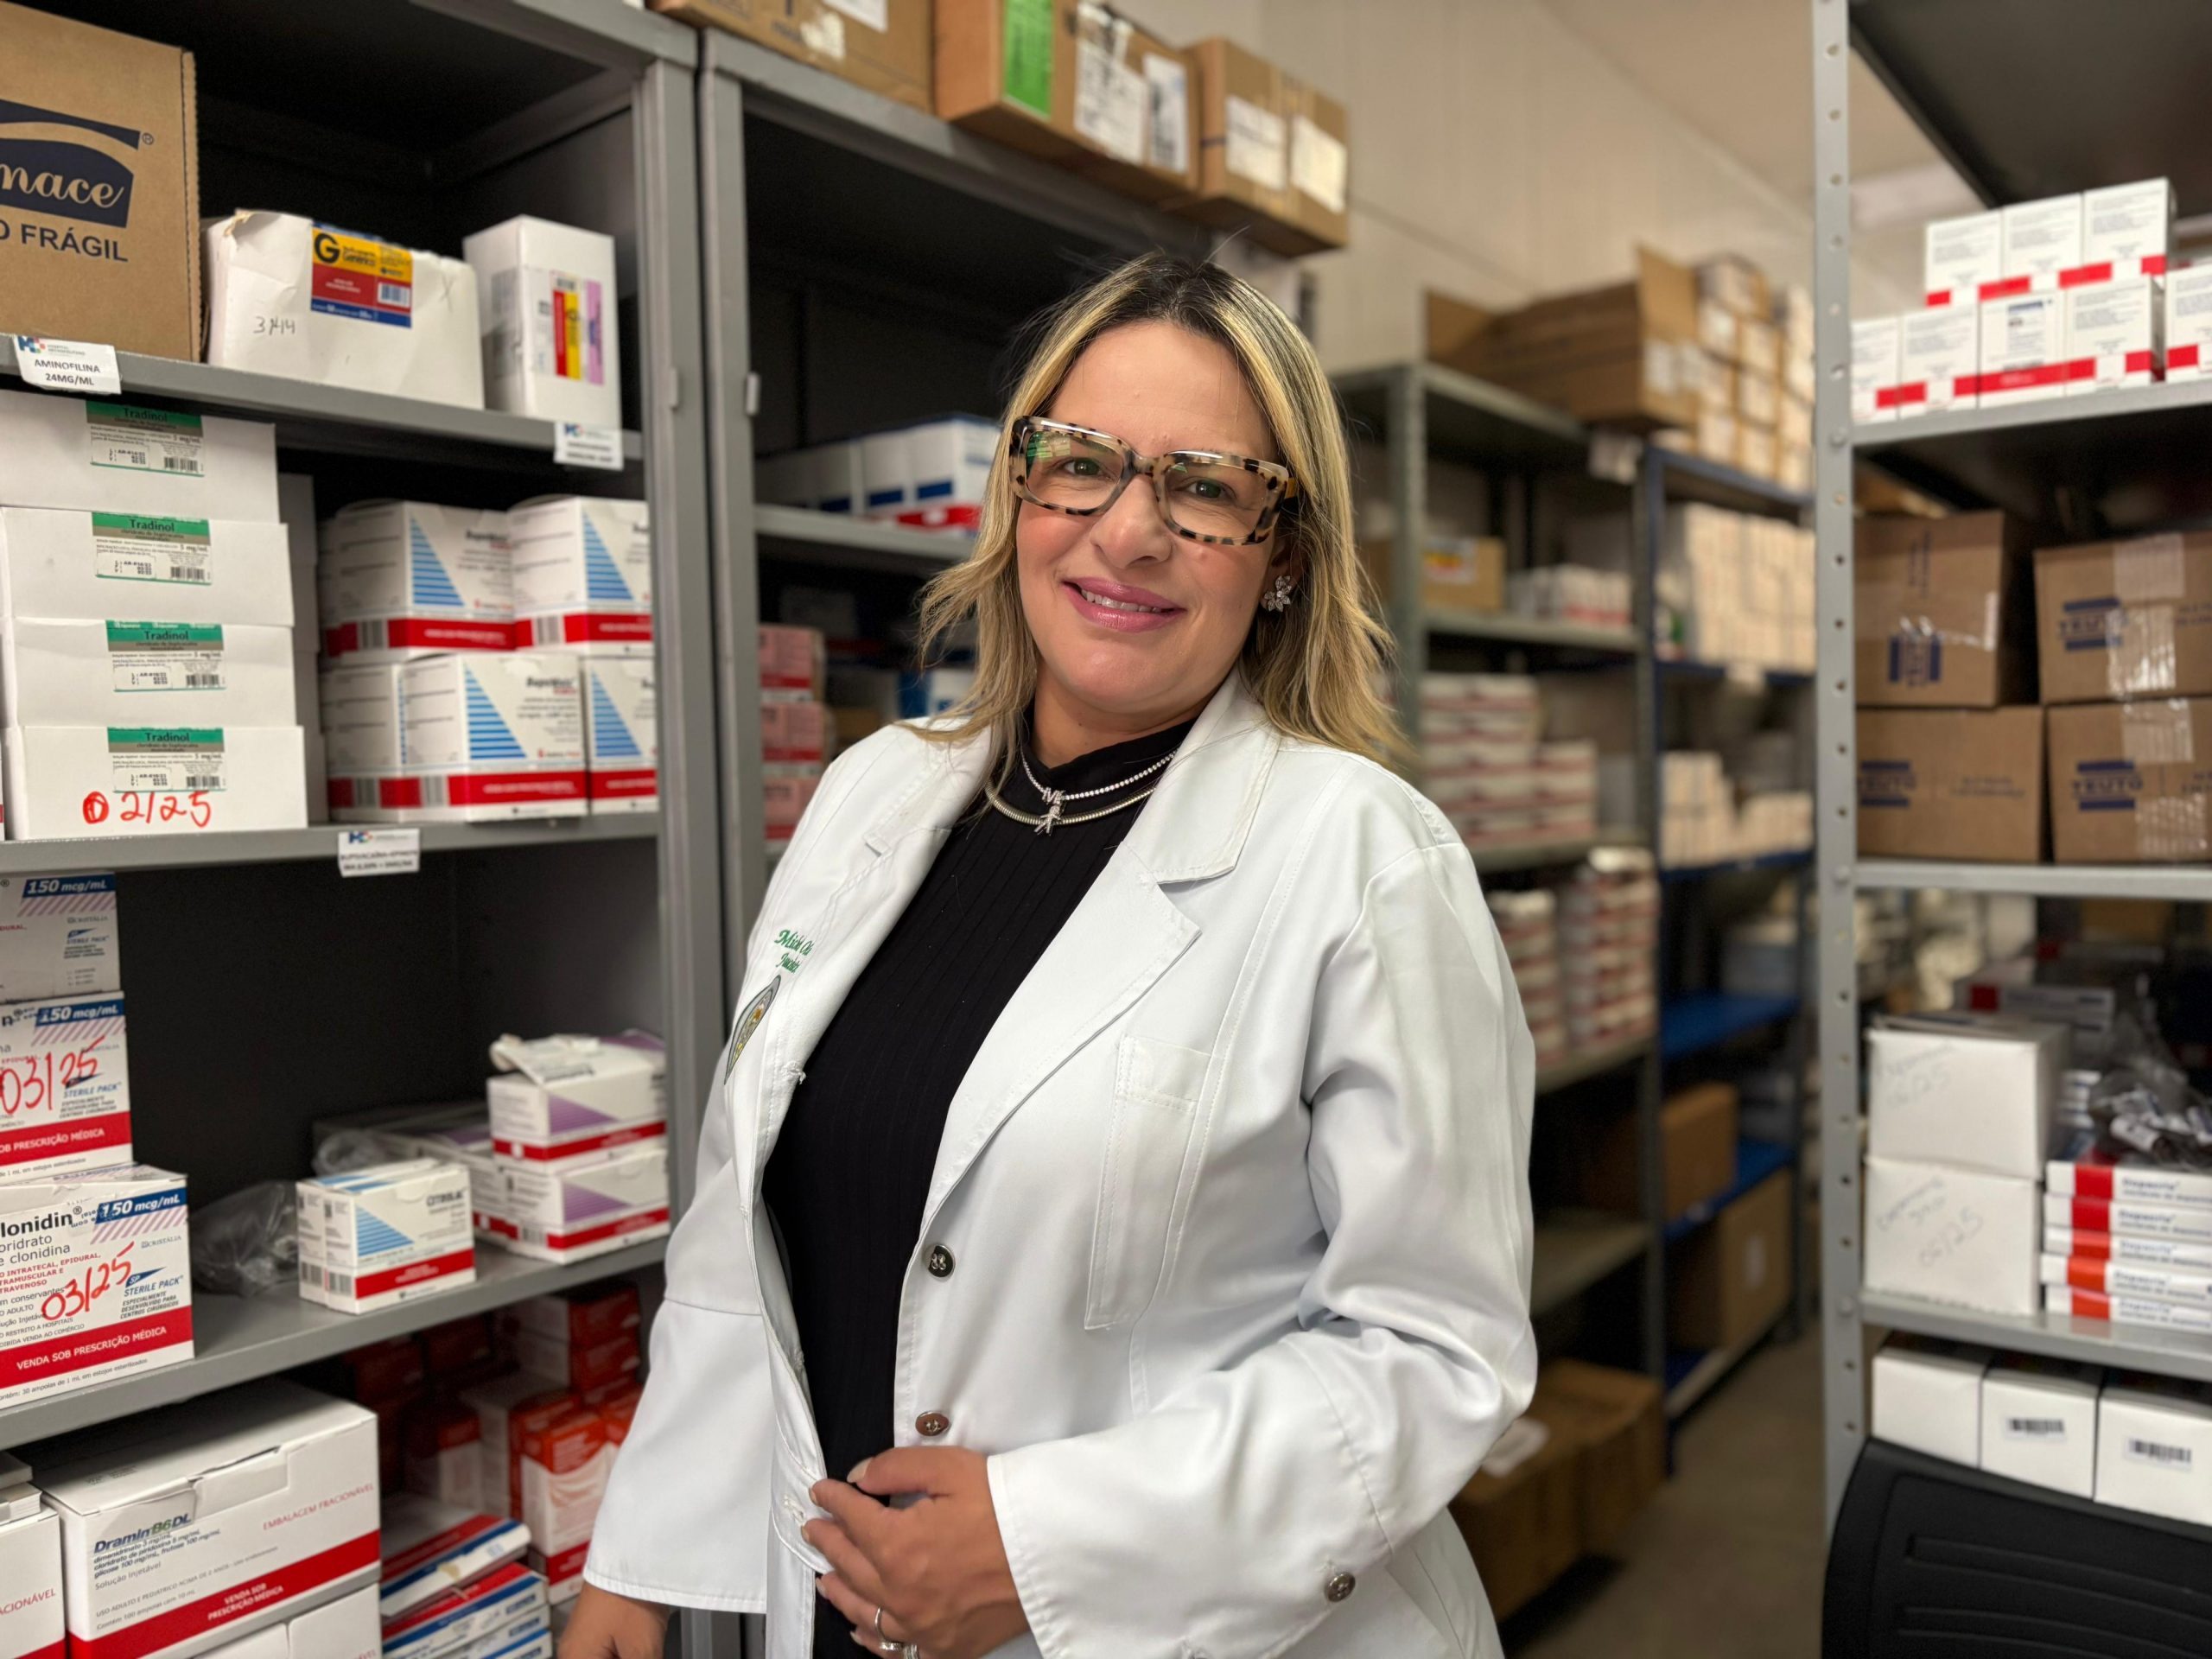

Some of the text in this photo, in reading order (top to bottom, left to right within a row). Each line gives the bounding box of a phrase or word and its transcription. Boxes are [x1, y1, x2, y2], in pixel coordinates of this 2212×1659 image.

[21, 223, 128, 262] FRÁGIL
[314, 232, 340, 264] G
[35, 359, 101, 373] AMINOFILINA
[45, 373, 95, 386] 24MG/ML
[124, 407, 168, 423] Tradinol
[129, 518, 175, 532] Tradinol
[144, 631, 189, 640] Tradinol
[145, 733, 190, 742] Tradinol
[28, 879, 107, 894] 150 mcg/mL
[39, 1007, 72, 1023] 150
[73, 1005, 118, 1019] mcg/mL
[64, 1084, 118, 1098] STERILE PACK
[14, 1134, 69, 1151] PRESCRIÇÃO
[71, 1128, 105, 1141] MÉDICA
[101, 1201, 132, 1217] 150
[135, 1194, 181, 1211] mcg/mL
[10, 1244, 70, 1264] clonidina
[7, 1262, 58, 1277] INTRATECAL,
[60, 1253, 101, 1266] EPIDURAL,
[0, 1268, 56, 1287] TRAMUSCULAR
[0, 1280, 47, 1294] TRAVENOSO
[41, 1241, 134, 1321] 03/25
[10, 1287, 66, 1304] conservantes
[123, 1291, 167, 1306] ESPECIALMENTE
[124, 1282, 156, 1298] STERILE
[7, 1304, 34, 1315] ADULTO
[121, 1294, 176, 1313] DESENVOLVIDO PARA
[120, 1309, 145, 1319] CENTROS
[5, 1325, 35, 1337] RESTRITO
[42, 1318, 73, 1329] HOSPITAIS
[22, 1334, 42, 1343] VENDA
[54, 1324, 85, 1336] COMÉRCIO
[16, 1326, 167, 1370] VENDA SOB PRESCRIÇÃO MÉDICA
[31, 1381, 56, 1393] ampolas
[92, 1367, 112, 1378] estojos
[114, 1357, 148, 1371] esterilizados
[263, 1483, 375, 1530] EMBALAGEM FRACIONÁVEL
[94, 1545, 141, 1564] dimenidrinato
[94, 1555, 127, 1571] cloridrato
[138, 1541, 171, 1556] piridoxina
[94, 1565, 118, 1580] glicose
[162, 1542, 184, 1554] frutose
[95, 1574, 126, 1591] Solução
[96, 1608, 111, 1618] USO
[111, 1598, 137, 1611] ADULTO
[179, 1576, 198, 1587] ACIMA
[207, 1585, 284, 1621] PRESCRIÇÃO MÉDICA
[225, 1582, 267, 1605] VENDA SOB
[97, 1617, 122, 1630] Contém
[124, 1611, 136, 1620] 100
[137, 1601, 162, 1616] ampolas
